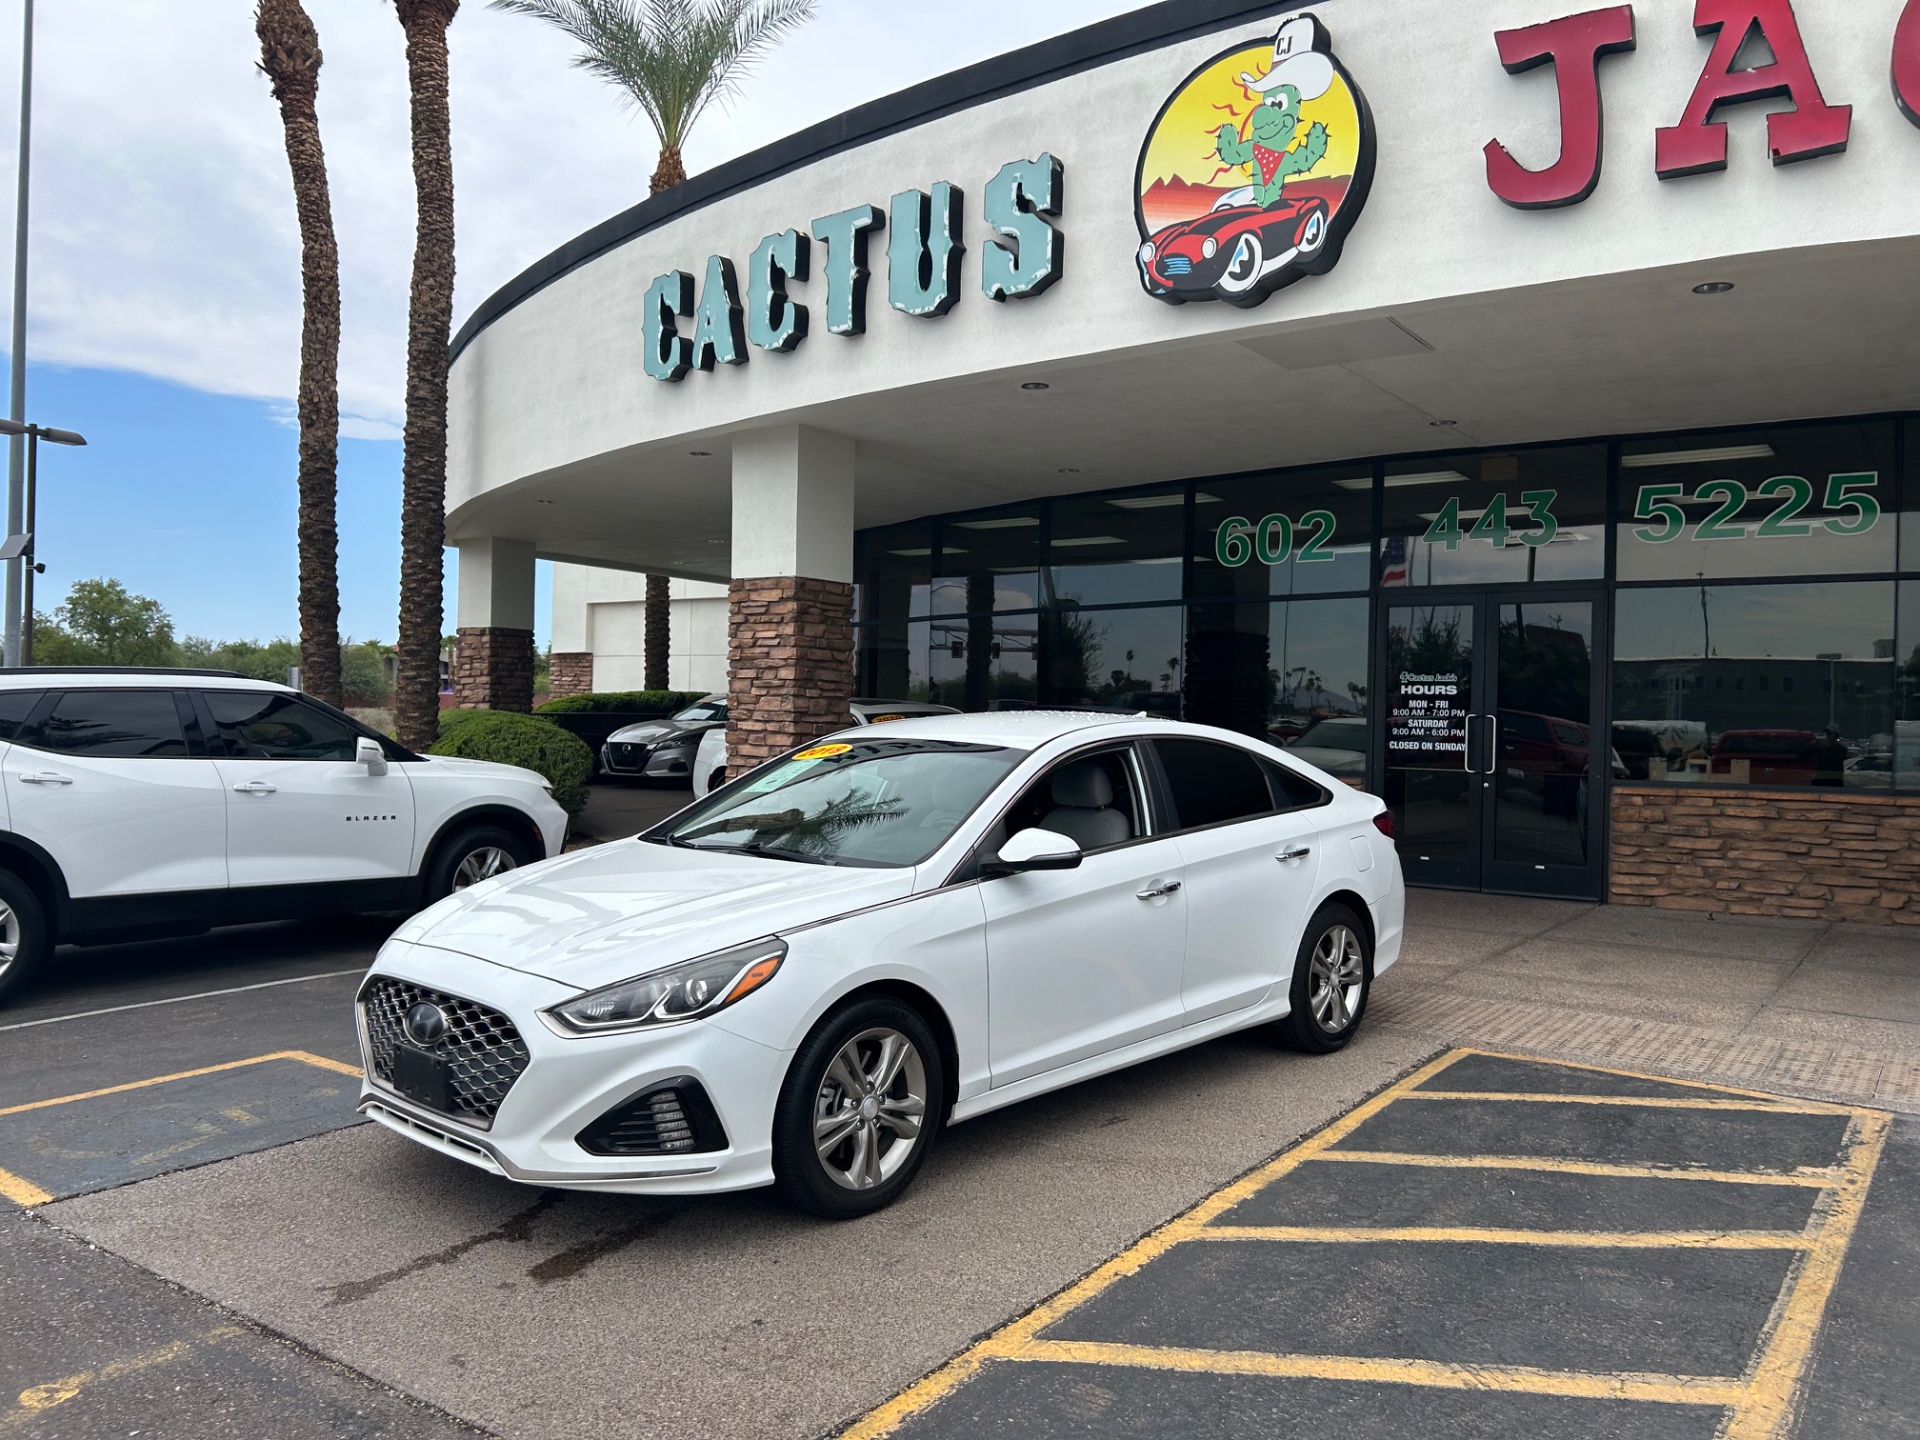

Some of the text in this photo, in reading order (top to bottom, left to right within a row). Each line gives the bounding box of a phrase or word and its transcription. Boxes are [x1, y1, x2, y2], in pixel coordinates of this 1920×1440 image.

[1276, 35, 1293, 55] CJ
[641, 151, 1065, 383] CACTUS
[1215, 471, 1881, 567] 602 443 5225
[1400, 684, 1458, 695] HOURS
[1408, 699, 1428, 709] MON
[1435, 700, 1449, 709] FRI
[1392, 708, 1410, 716] 9:00
[1410, 708, 1425, 716] AM
[1432, 709, 1450, 717] 7:00
[1451, 709, 1465, 717] PM
[1407, 719, 1449, 728] SATURDAY
[1391, 727, 1409, 735] 9:00
[1410, 728, 1425, 736] AM
[1431, 728, 1450, 736] 6:00
[1450, 729, 1465, 737] PM
[1389, 740, 1466, 751] CLOSED ON SUNDAY
